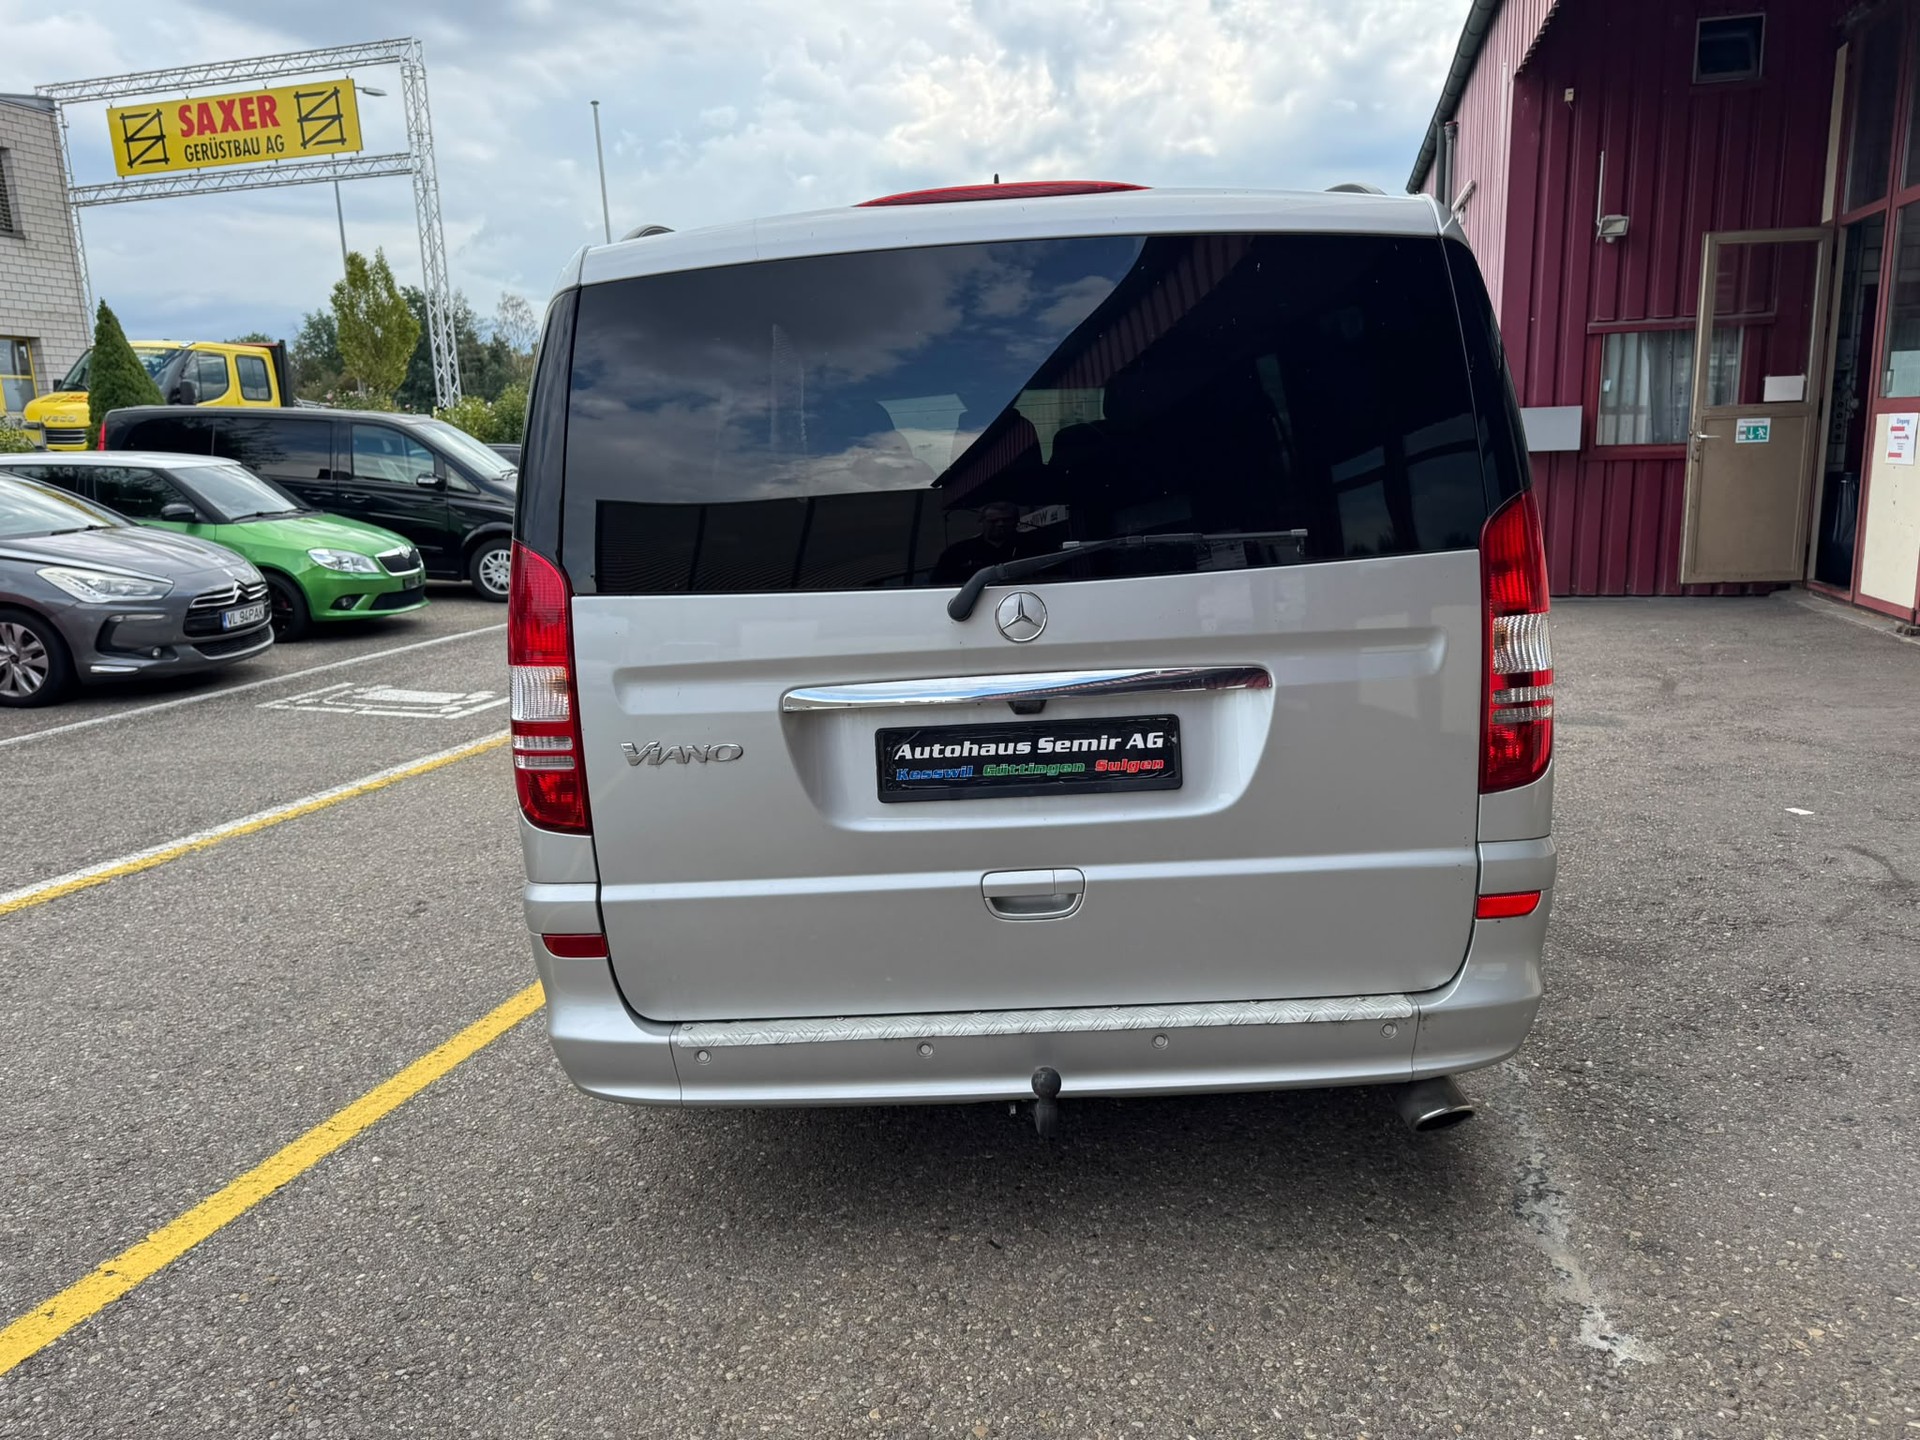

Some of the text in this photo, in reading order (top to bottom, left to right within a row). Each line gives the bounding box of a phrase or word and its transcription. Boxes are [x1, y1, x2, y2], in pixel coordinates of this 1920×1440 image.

[178, 95, 280, 137] SAXER
[184, 134, 285, 163] GERÜSTBAU AG
[227, 613, 238, 625] VL
[895, 732, 1164, 760] Autohaus Semir AG
[896, 765, 974, 781] Kesswil
[1094, 758, 1165, 774] Sulgen
